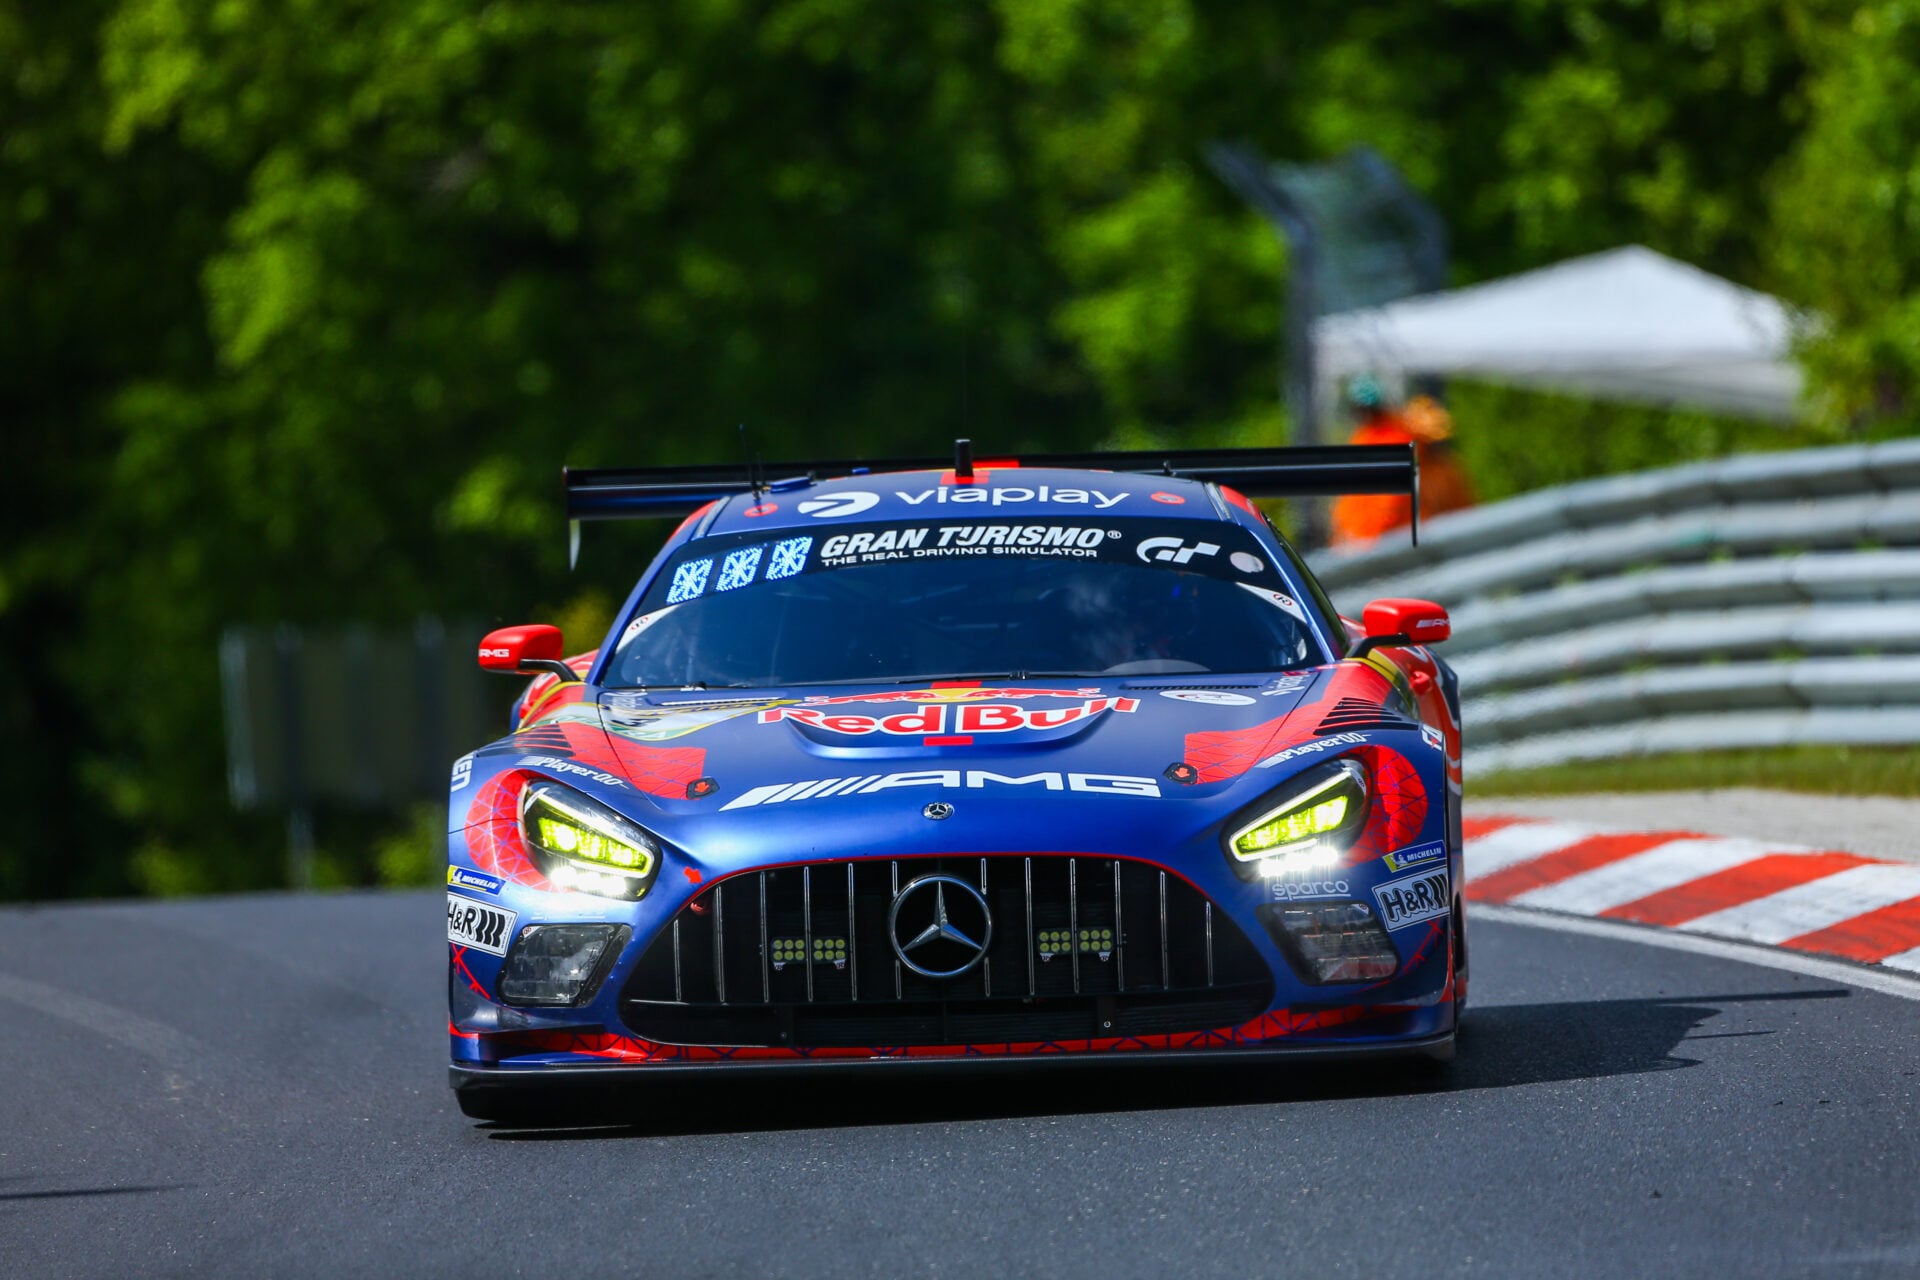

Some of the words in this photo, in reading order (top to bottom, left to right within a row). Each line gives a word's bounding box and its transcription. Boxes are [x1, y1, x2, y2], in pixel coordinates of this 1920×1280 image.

[895, 486, 1131, 509] viaplay
[820, 528, 929, 558] GRAN
[821, 555, 858, 567] THE
[862, 551, 909, 562] REAL
[913, 547, 987, 557] DRIVING
[992, 546, 1097, 558] SIMULATOR
[758, 704, 942, 735] Red
[956, 696, 1142, 734] Bull
[856, 769, 1162, 798] AMG
[1407, 847, 1442, 861] MICHELIN
[461, 875, 498, 890] MICHELIN
[1272, 880, 1349, 900] sparco
[1381, 882, 1435, 920] H&R
